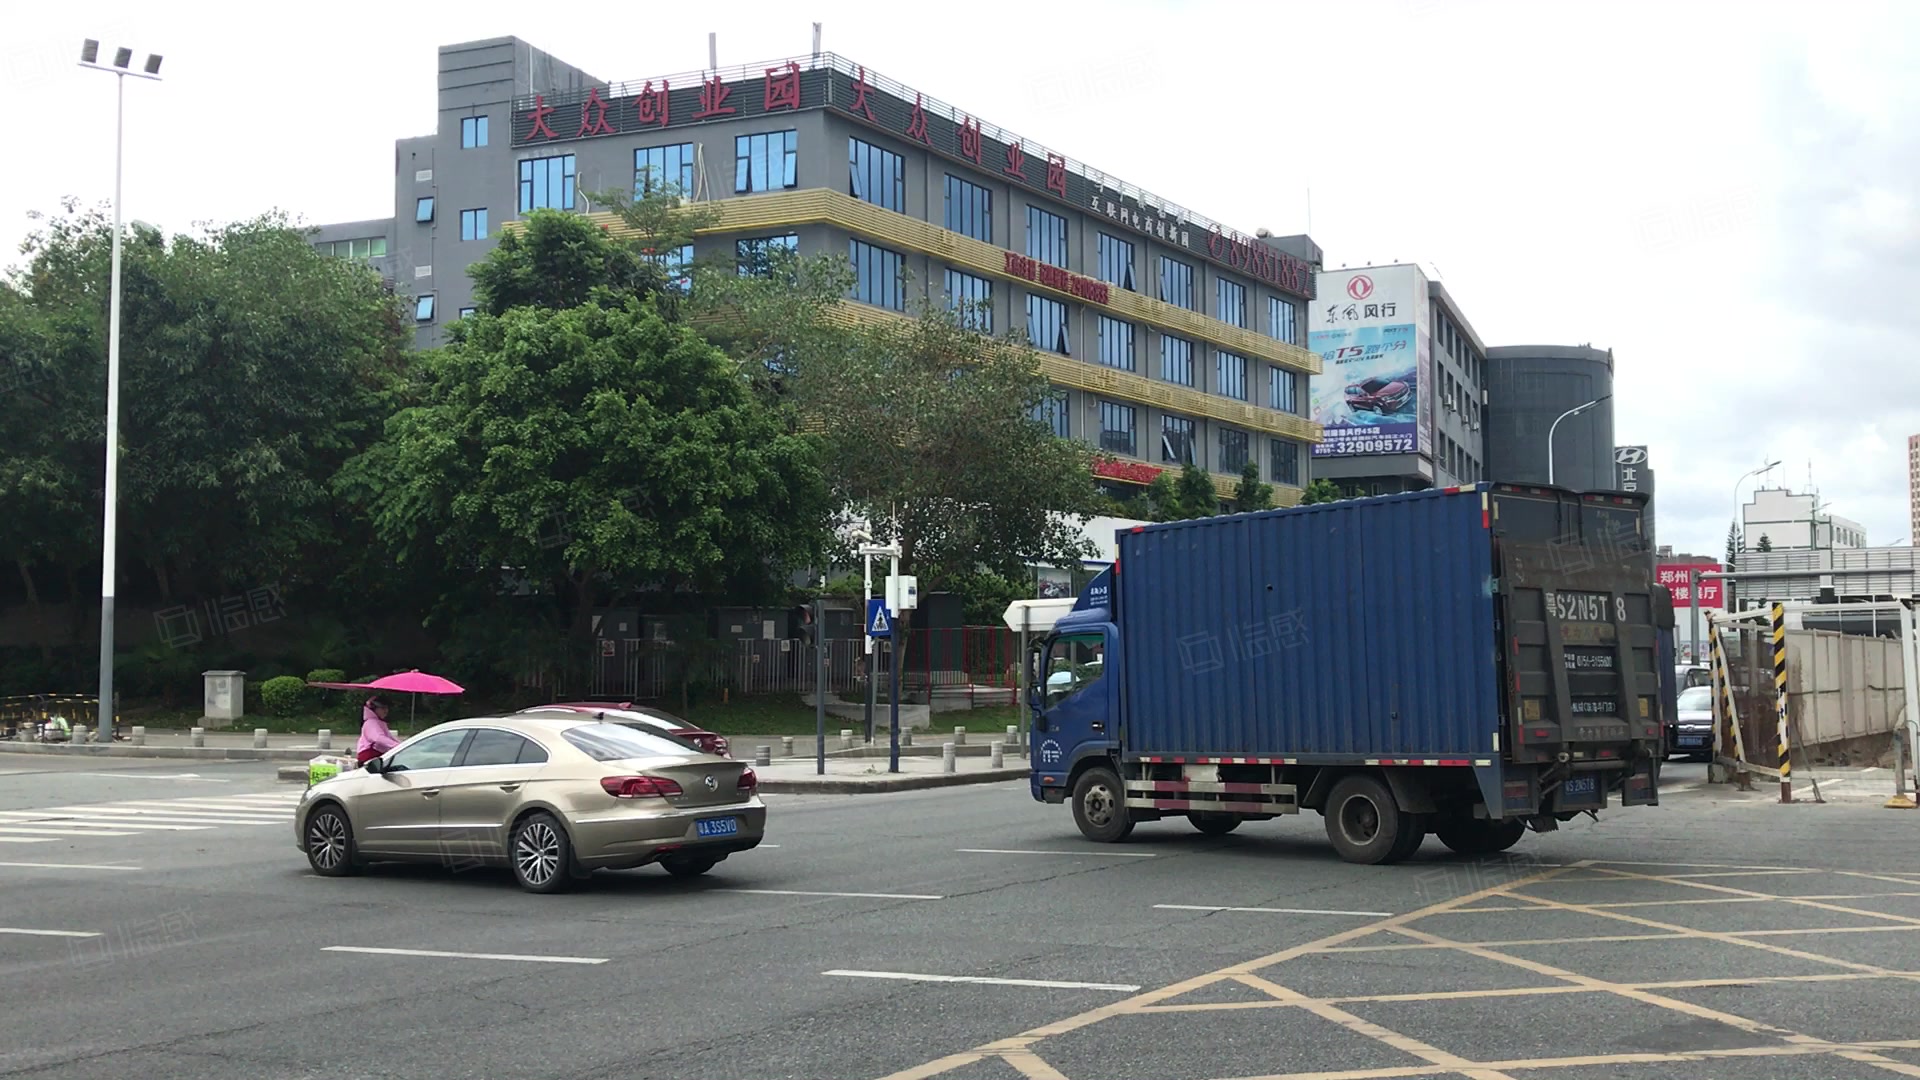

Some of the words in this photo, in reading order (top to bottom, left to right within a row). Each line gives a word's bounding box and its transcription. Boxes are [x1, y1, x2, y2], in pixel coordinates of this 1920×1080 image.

[524, 62, 801, 142] 大众创业园
[850, 67, 1067, 198] 大众创业园
[1337, 439, 1413, 454] 32909572
